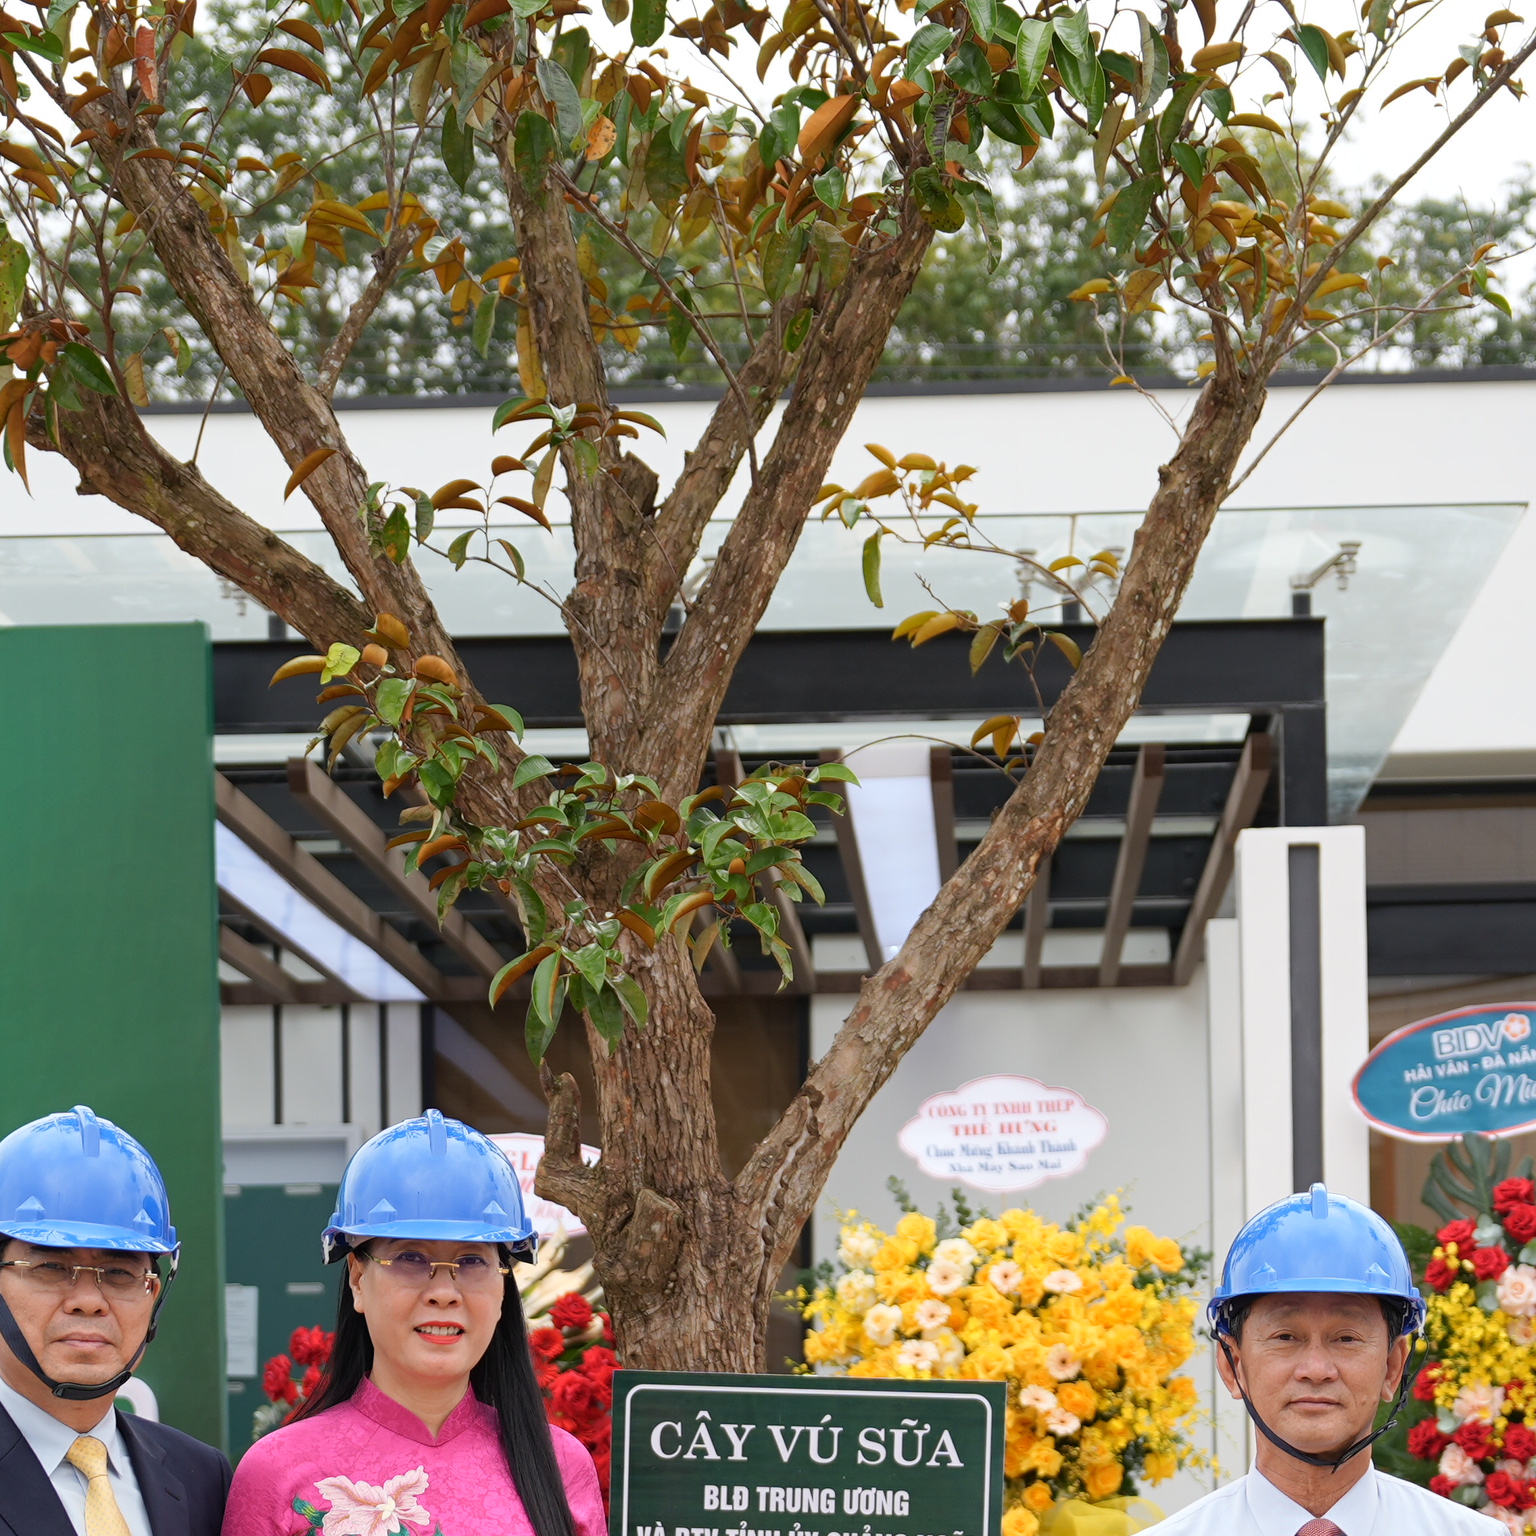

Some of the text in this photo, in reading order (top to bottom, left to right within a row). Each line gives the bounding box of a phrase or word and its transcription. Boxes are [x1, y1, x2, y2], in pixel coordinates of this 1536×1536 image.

[1434, 1021, 1505, 1058] BIDV
[1481, 1051, 1507, 1070] ĐÀ
[971, 1103, 988, 1116] TY
[994, 1101, 1033, 1115] TNHH
[1409, 1085, 1472, 1121] Chúc
[650, 1410, 964, 1468] CÂY VÚ SỮA
[704, 1485, 910, 1516] BLĐ TRUNG ƯƠNG
